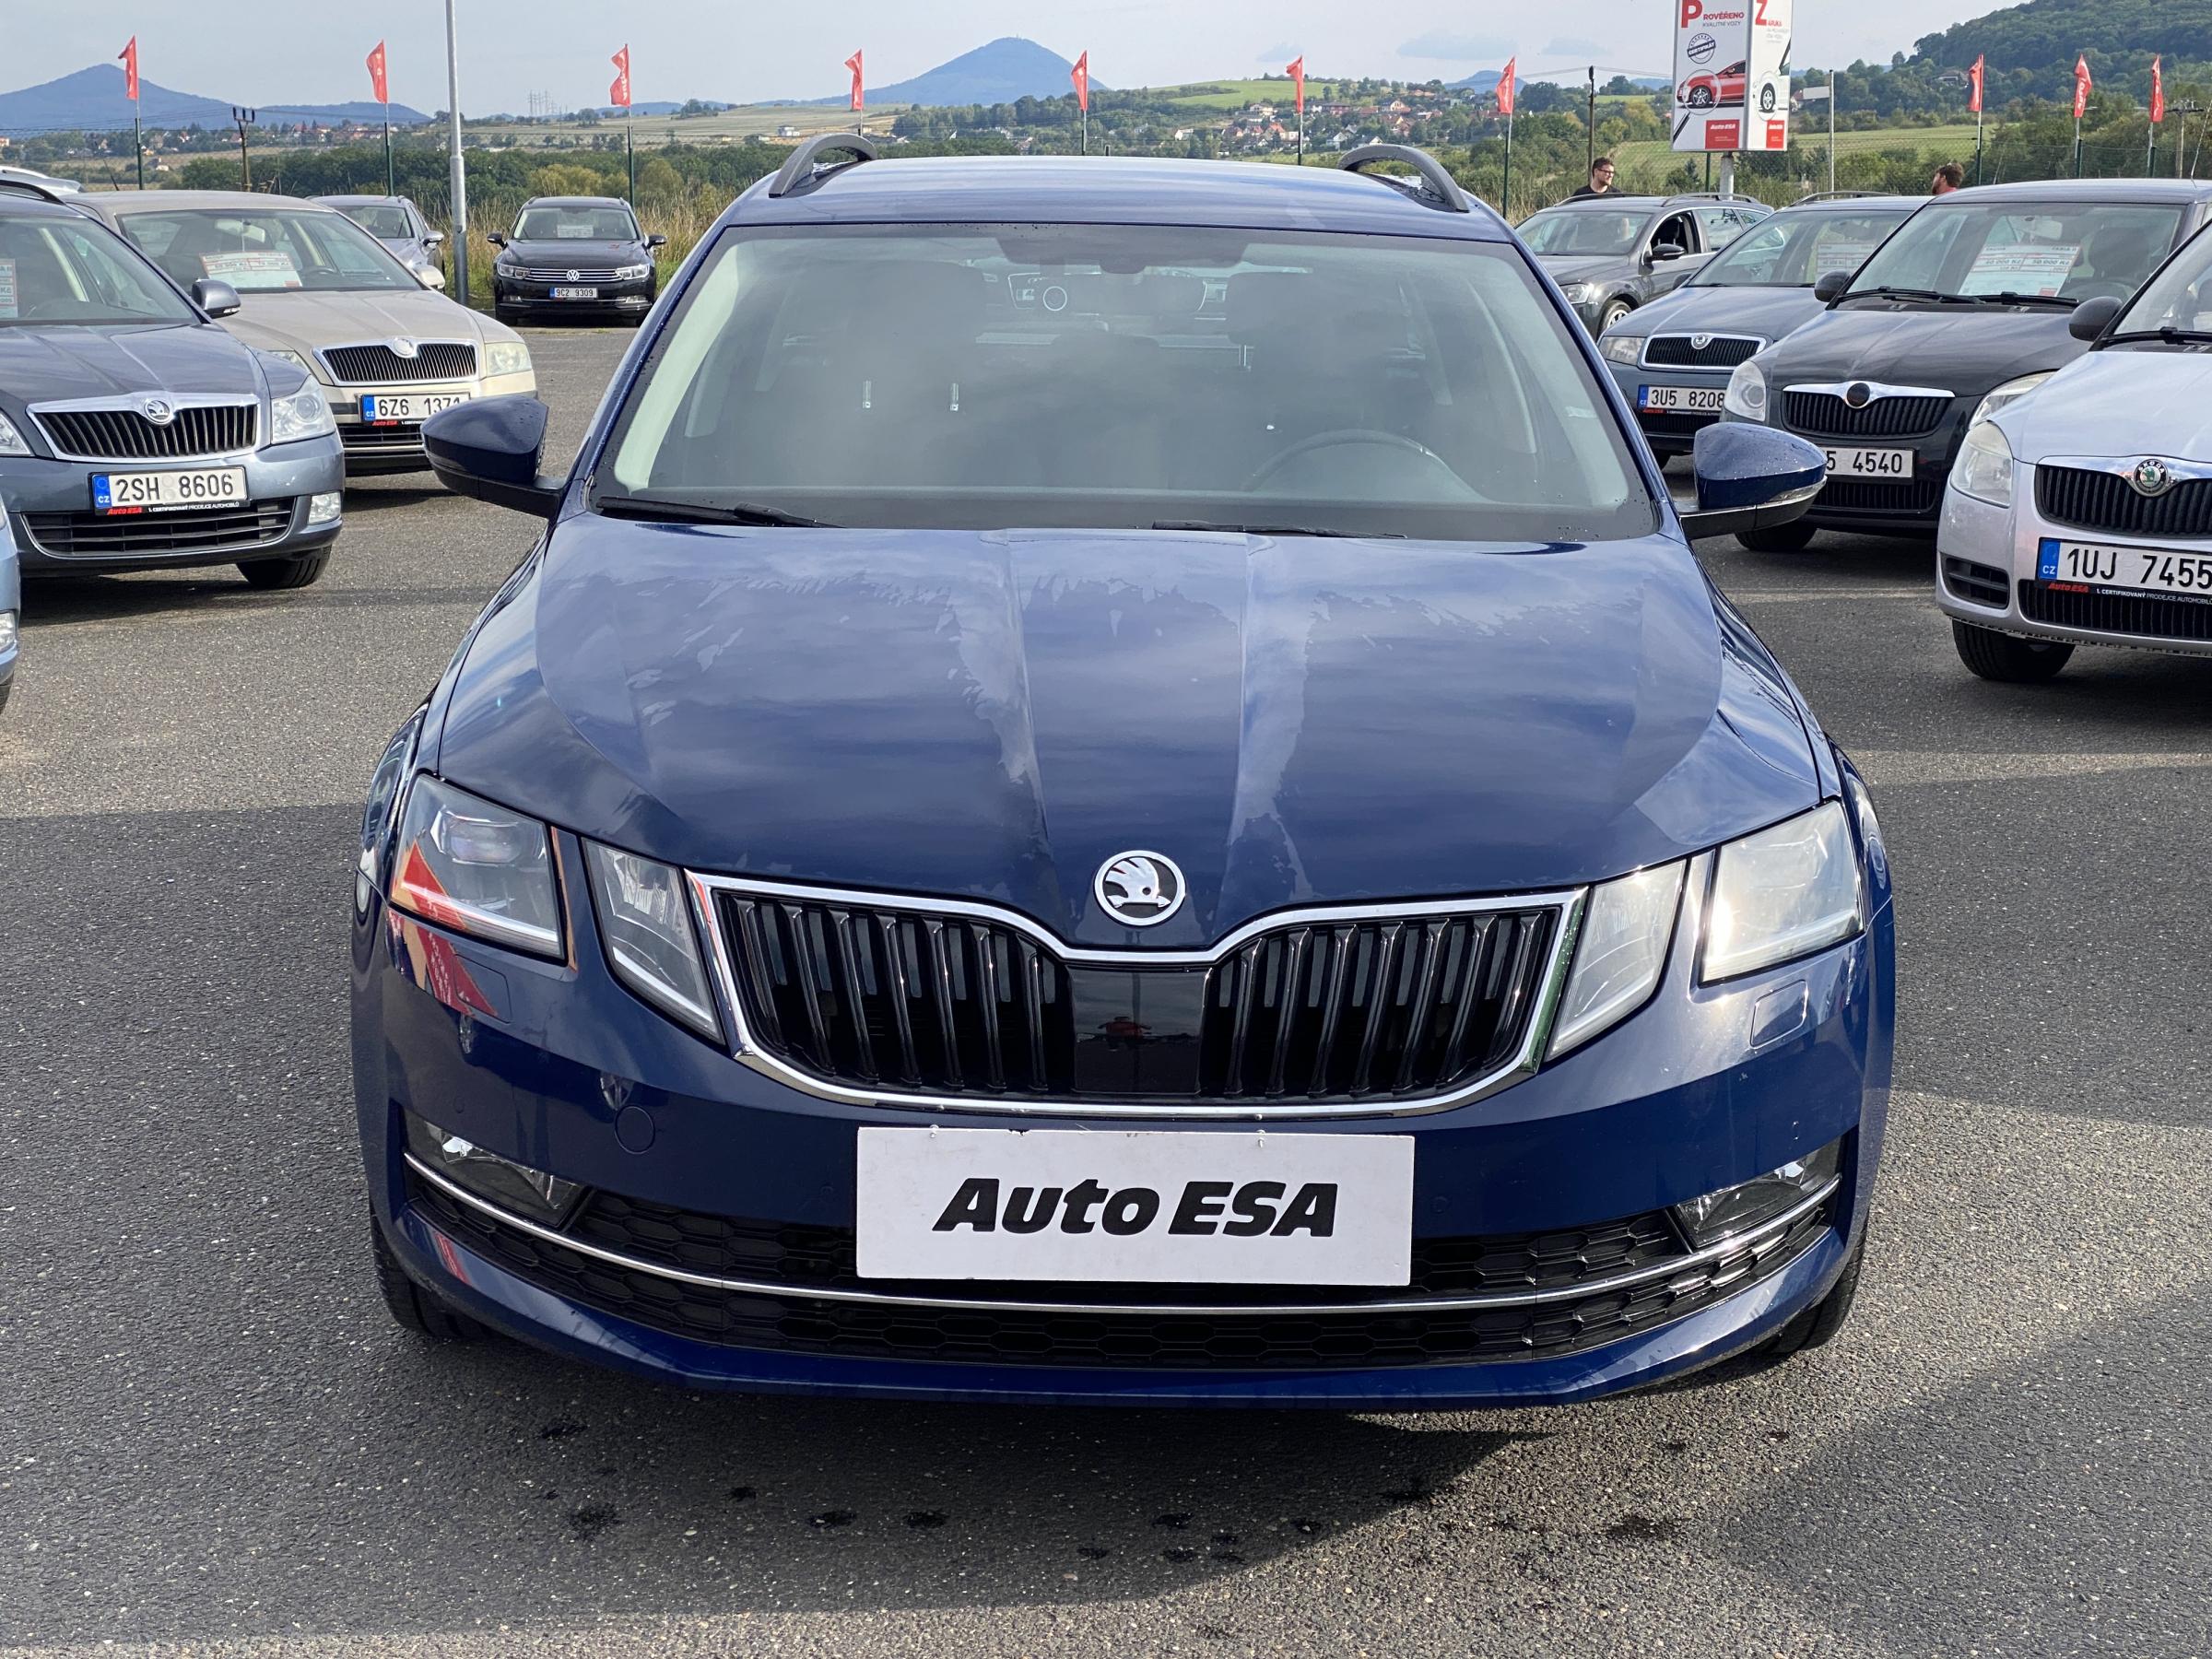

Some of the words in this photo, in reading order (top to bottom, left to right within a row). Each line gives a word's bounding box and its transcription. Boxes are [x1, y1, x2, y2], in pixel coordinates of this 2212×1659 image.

[556, 288, 570, 297] 9C2
[574, 288, 594, 297] 9309
[379, 398, 409, 417] 6Z6
[1651, 389, 1677, 406] 3U5
[1688, 391, 1725, 408] 8208
[1853, 451, 1902, 474] 4540
[115, 477, 160, 502] 2SH
[178, 473, 234, 499] 8606
[98, 495, 110, 503] CZ
[2042, 565, 2056, 575] CZ
[2066, 547, 2118, 581] 1UJ
[2139, 554, 2212, 590] 7455
[2048, 582, 2071, 592] Auto
[2072, 583, 2089, 594] ESA
[2101, 589, 2147, 598] CERTIFIKOVANÝ
[2147, 594, 2176, 602] PRODEJCE
[932, 1177, 1160, 1236] Auto
[1167, 1181, 1339, 1238] ESA
